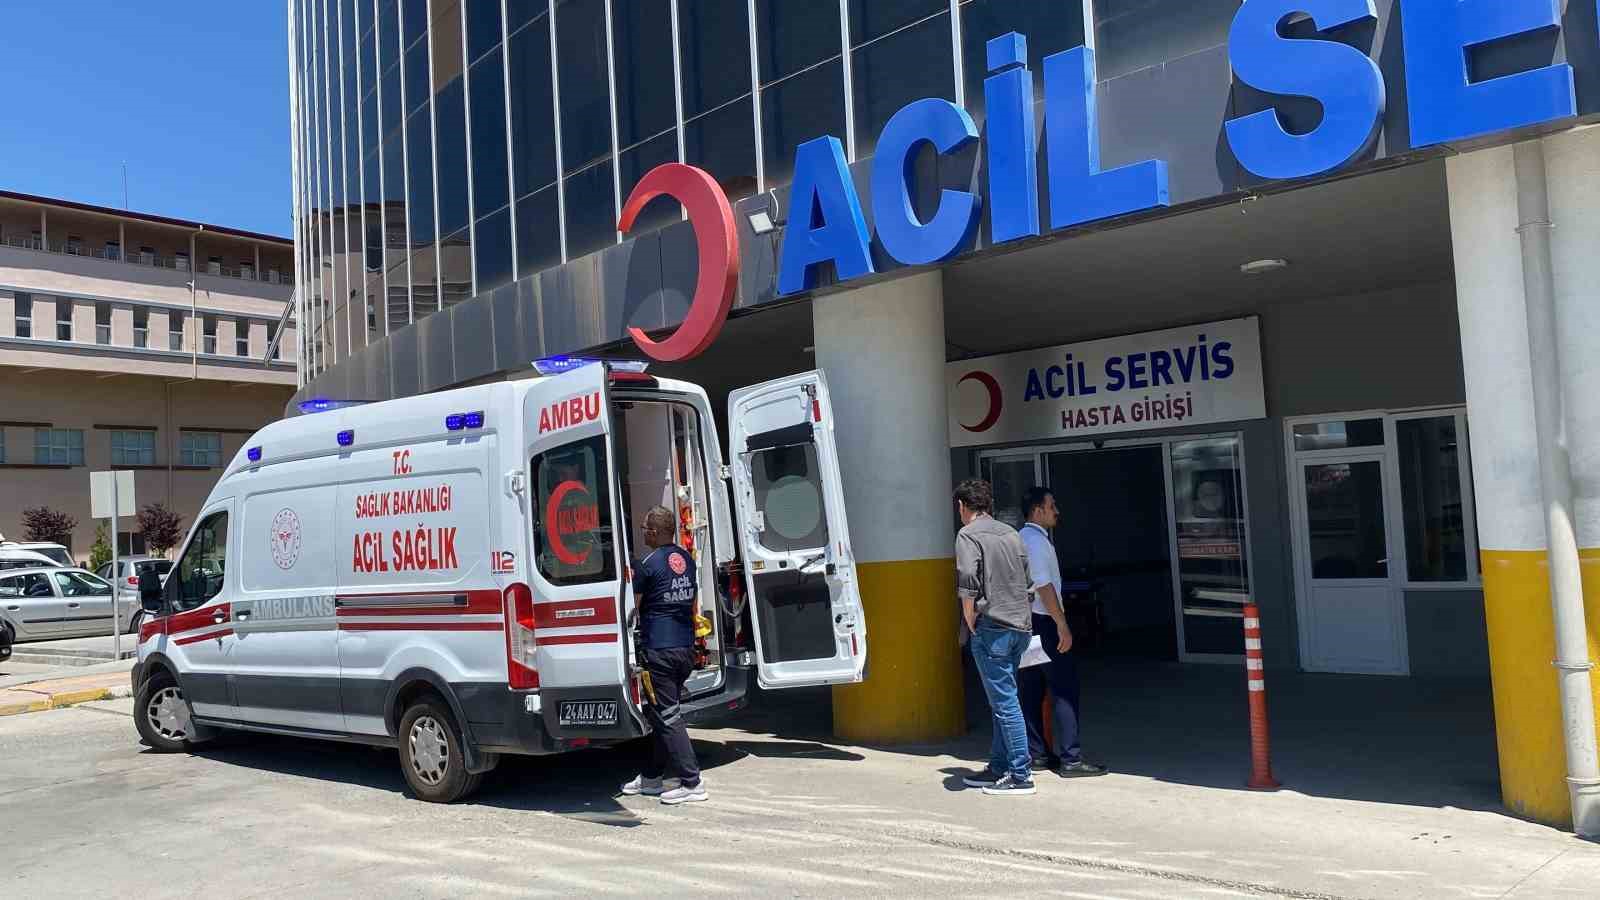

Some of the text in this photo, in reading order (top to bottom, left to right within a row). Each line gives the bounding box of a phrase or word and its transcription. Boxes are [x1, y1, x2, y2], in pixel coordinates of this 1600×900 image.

[778, 0, 1600, 295] ACİL SE
[1023, 334, 1234, 402] ACİL SERVİS
[538, 392, 600, 434] AMBU
[1061, 392, 1193, 430] HASTA GİRİŞİ
[392, 450, 412, 475] T.C.
[355, 483, 452, 519] SAĞLIK BAKANLIĞI
[392, 521, 458, 572] SAĞLIK
[491, 551, 515, 570] 112
[671, 574, 692, 589] ACİL
[252, 595, 332, 619] AMBULANS
